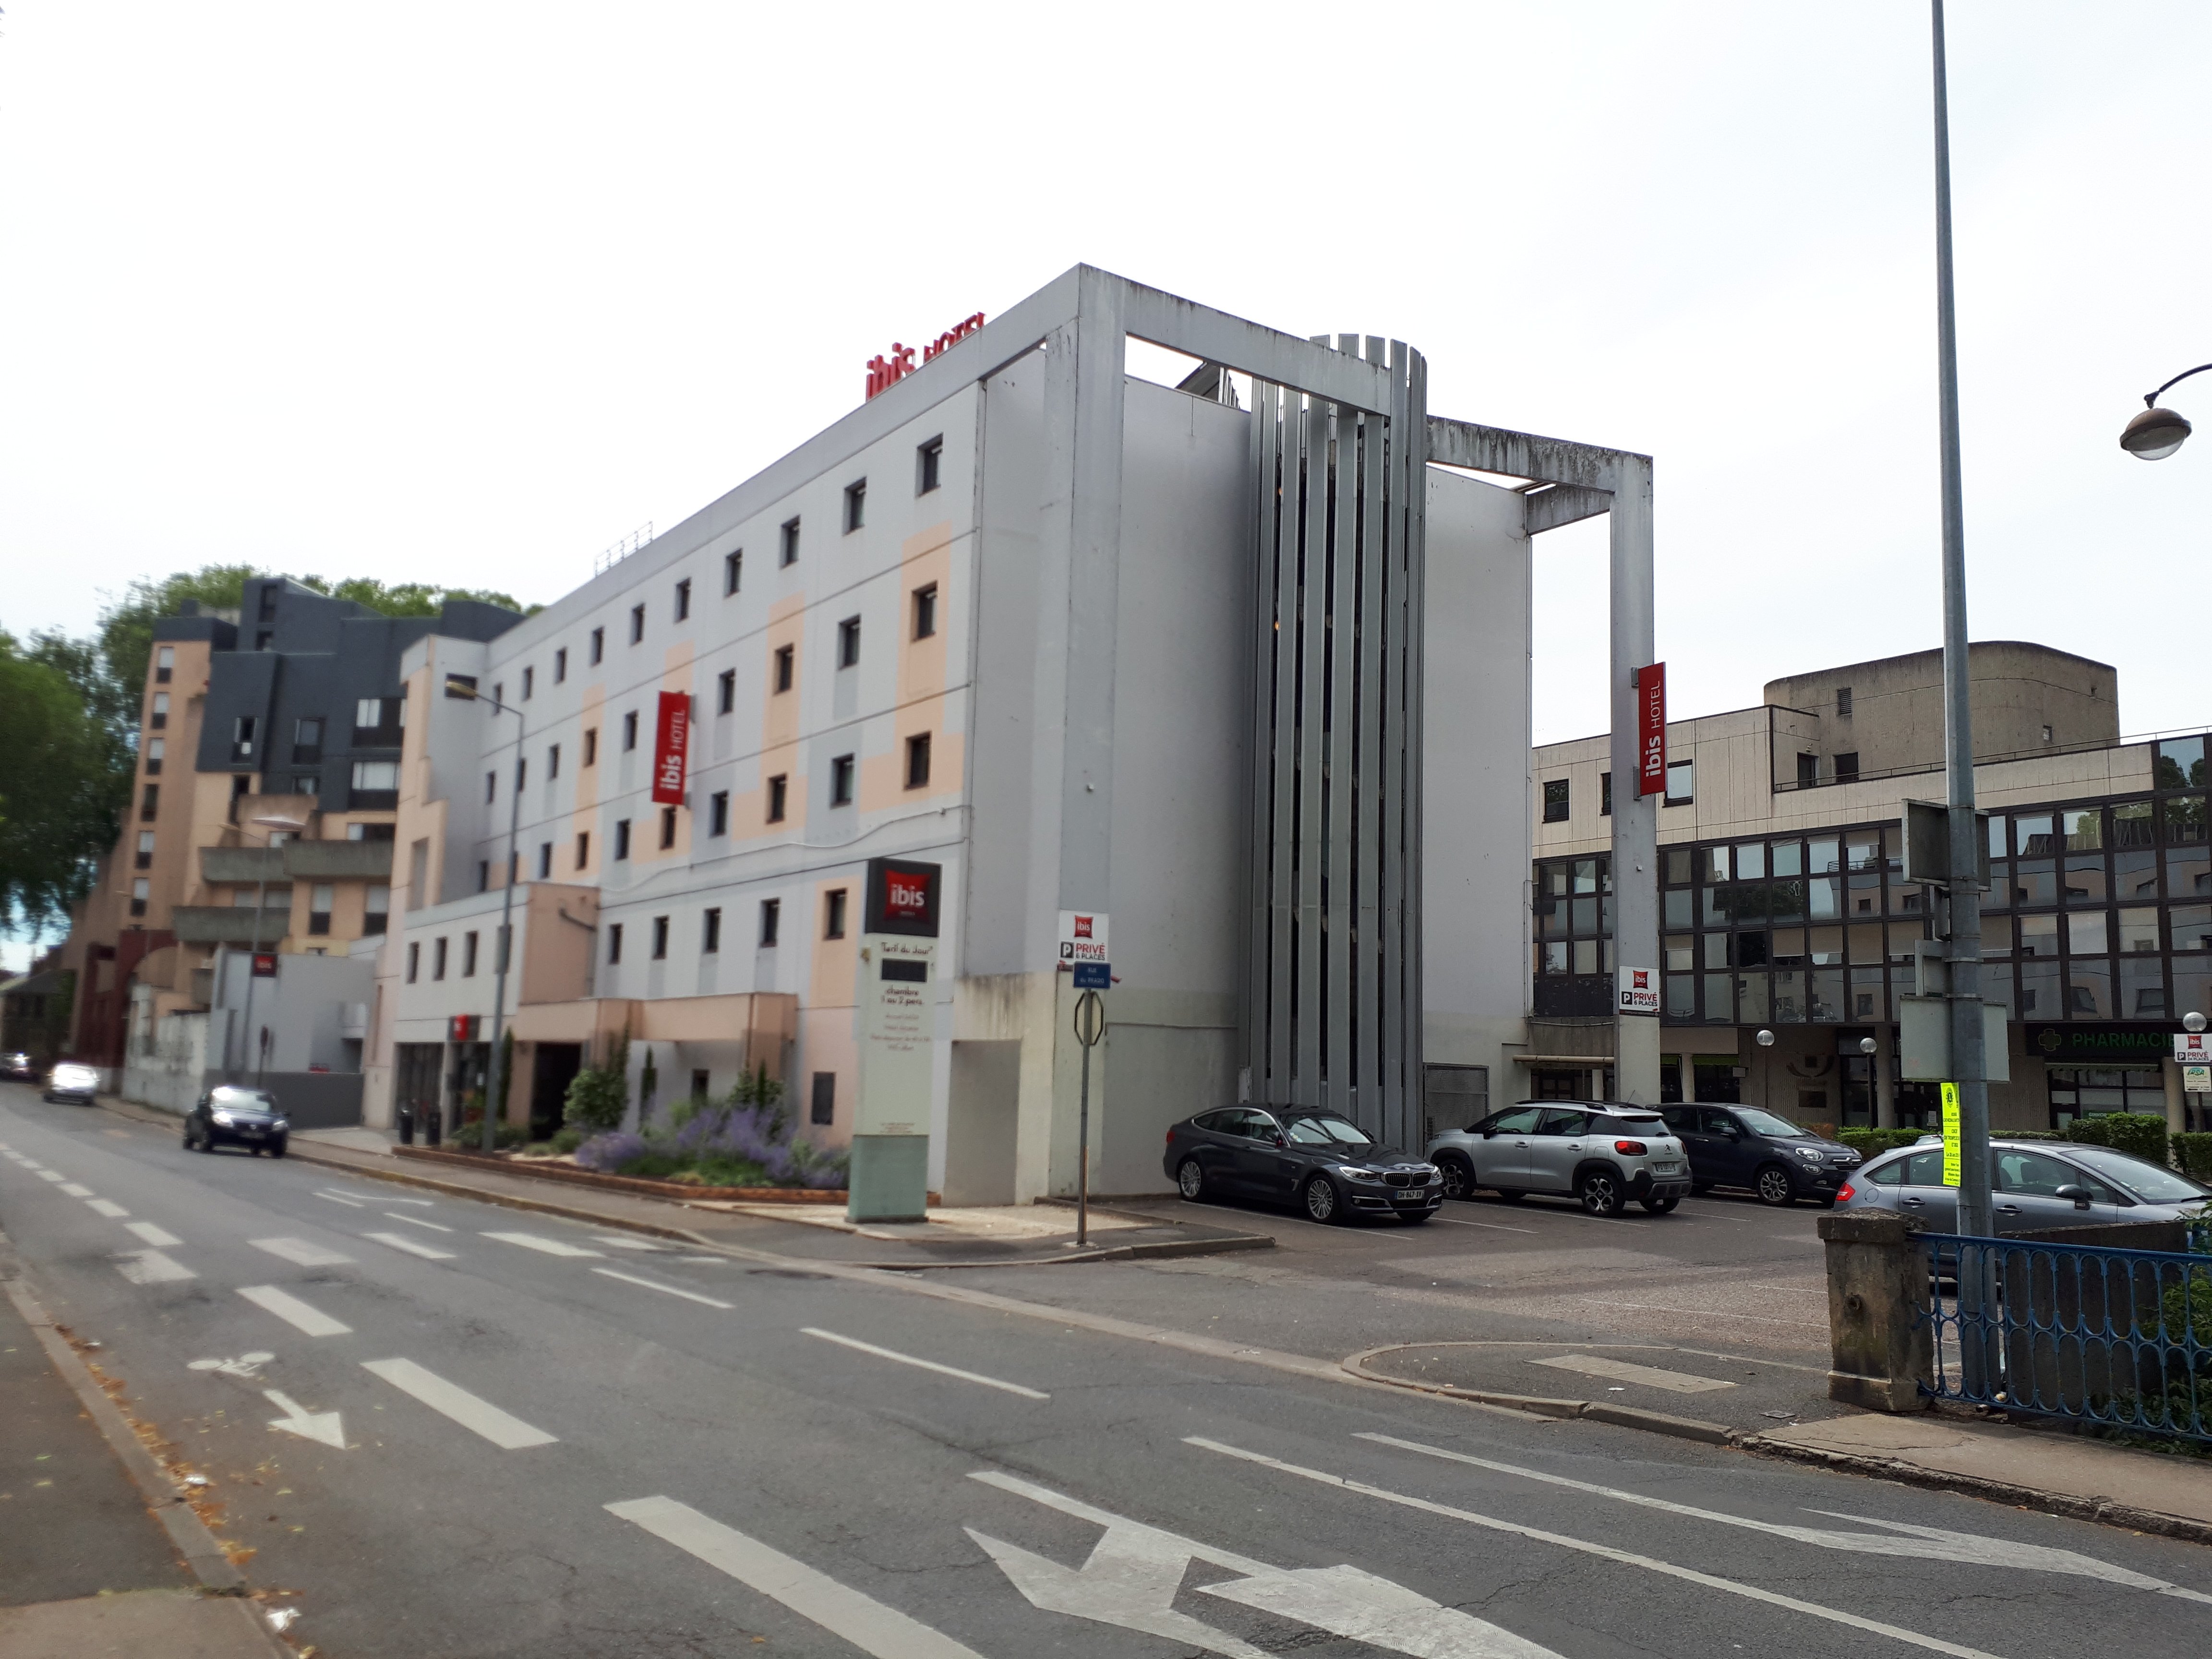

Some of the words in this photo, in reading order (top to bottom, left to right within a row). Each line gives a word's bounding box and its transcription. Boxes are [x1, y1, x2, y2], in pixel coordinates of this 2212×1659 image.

[1650, 680, 1660, 729] HOTEL
[1646, 735, 1661, 777] ibis
[659, 754, 683, 790] ibis
[890, 883, 925, 907] ibis
[1077, 921, 1091, 931] ibis
[1062, 944, 1072, 957] P
[1076, 942, 1106, 954] PRIVÉ
[1635, 975, 1646, 983] ibis
[1623, 993, 1631, 1003] P
[1634, 991, 1658, 1001] PRIVÉ
[2072, 1033, 2175, 1047] PHARMACIE
